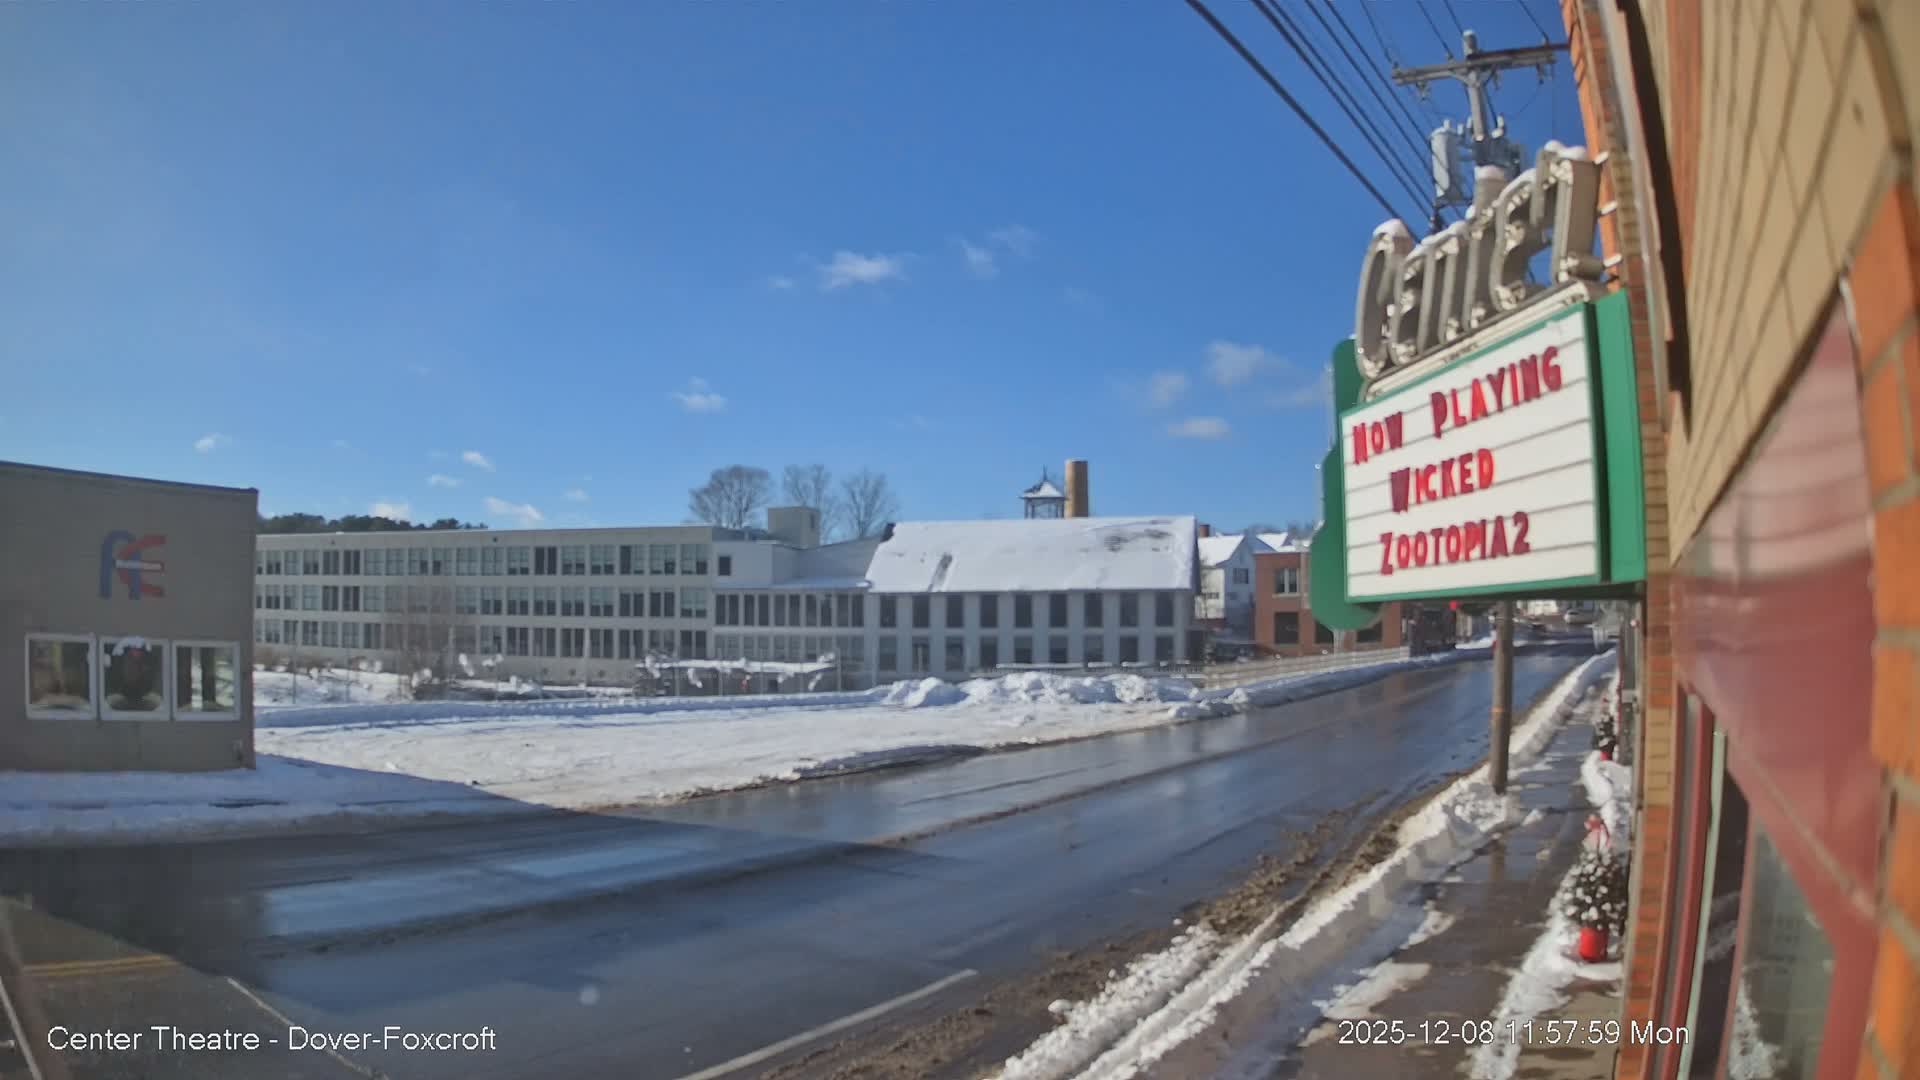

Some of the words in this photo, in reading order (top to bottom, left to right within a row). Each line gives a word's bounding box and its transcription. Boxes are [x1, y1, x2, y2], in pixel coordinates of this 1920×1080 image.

[1353, 411, 1403, 465] NOW
[1430, 346, 1562, 439] PLAYING
[1391, 448, 1494, 513] WICKED
